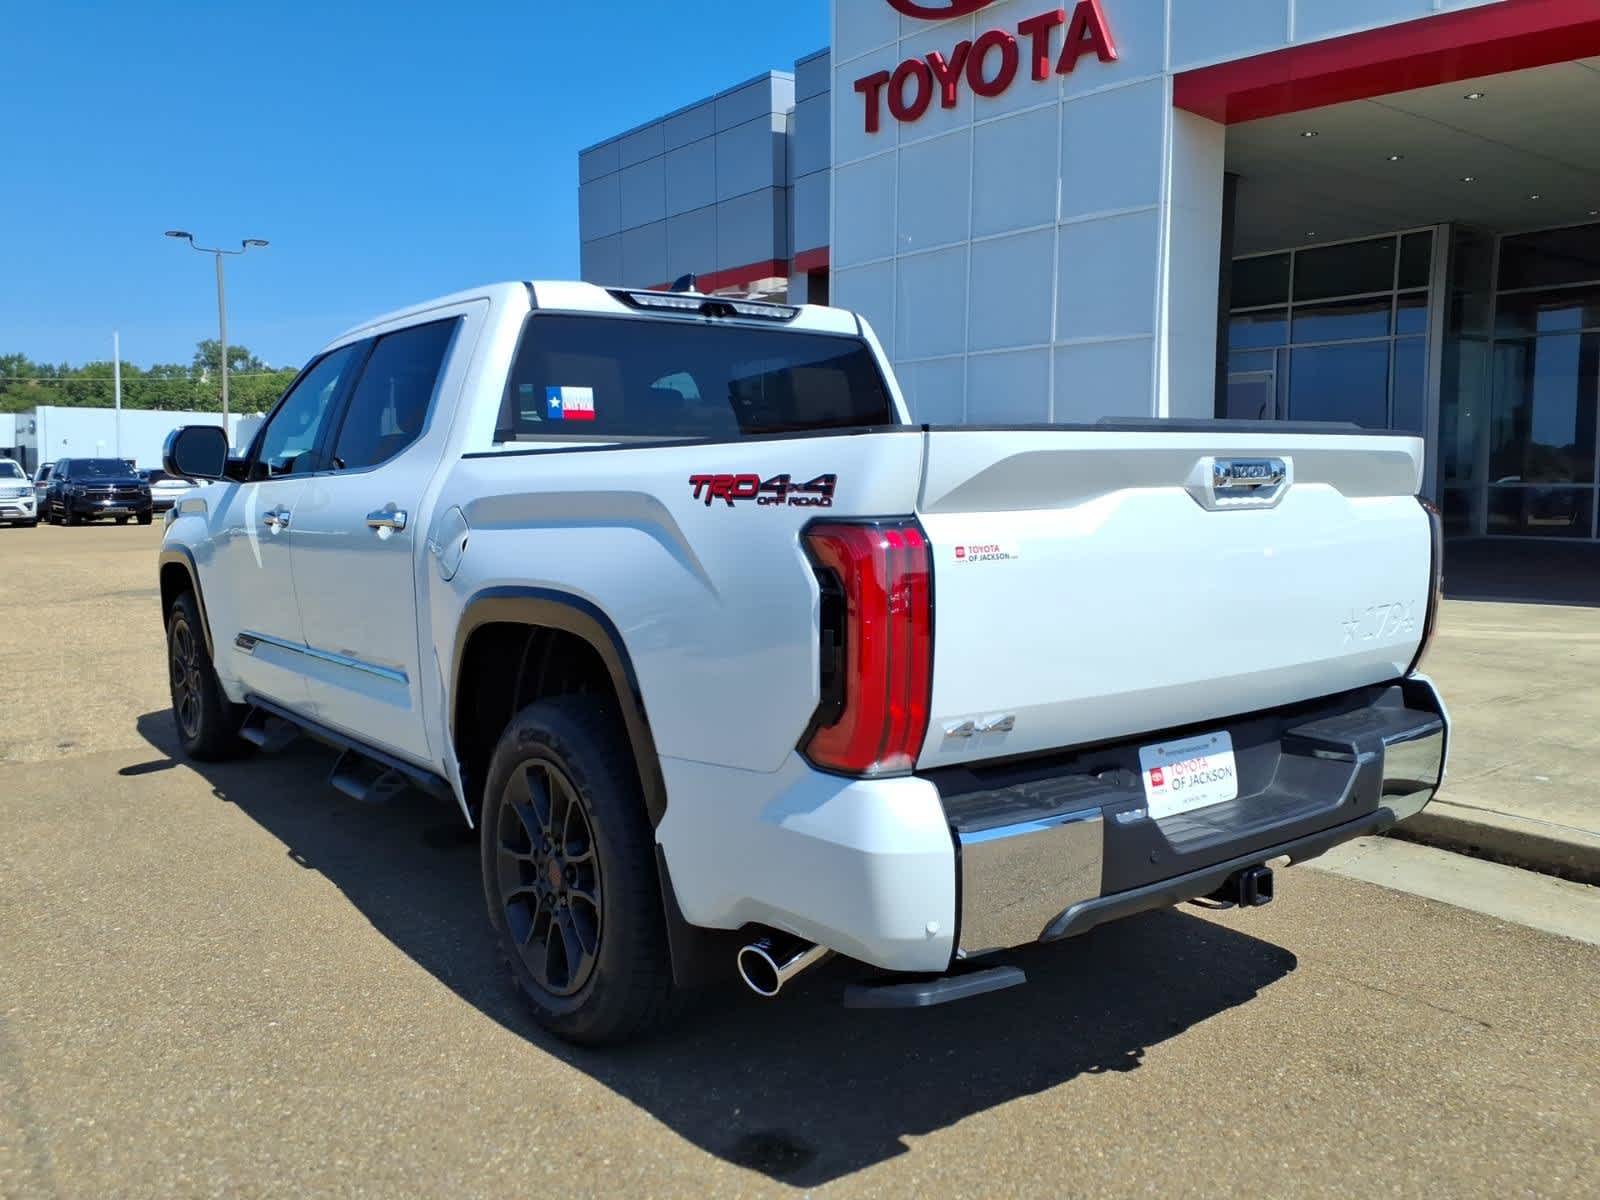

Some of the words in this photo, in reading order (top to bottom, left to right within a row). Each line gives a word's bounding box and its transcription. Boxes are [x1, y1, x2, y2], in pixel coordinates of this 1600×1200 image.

[854, 0, 1118, 133] TOYOTA
[689, 473, 760, 507] TRD
[757, 496, 785, 506] OFF
[788, 496, 832, 507] ROAD
[968, 545, 1000, 554] TOYOTA
[1168, 758, 1209, 776] TOYOTA
[1171, 777, 1187, 791] OF
[1188, 766, 1232, 788] JACKSON
